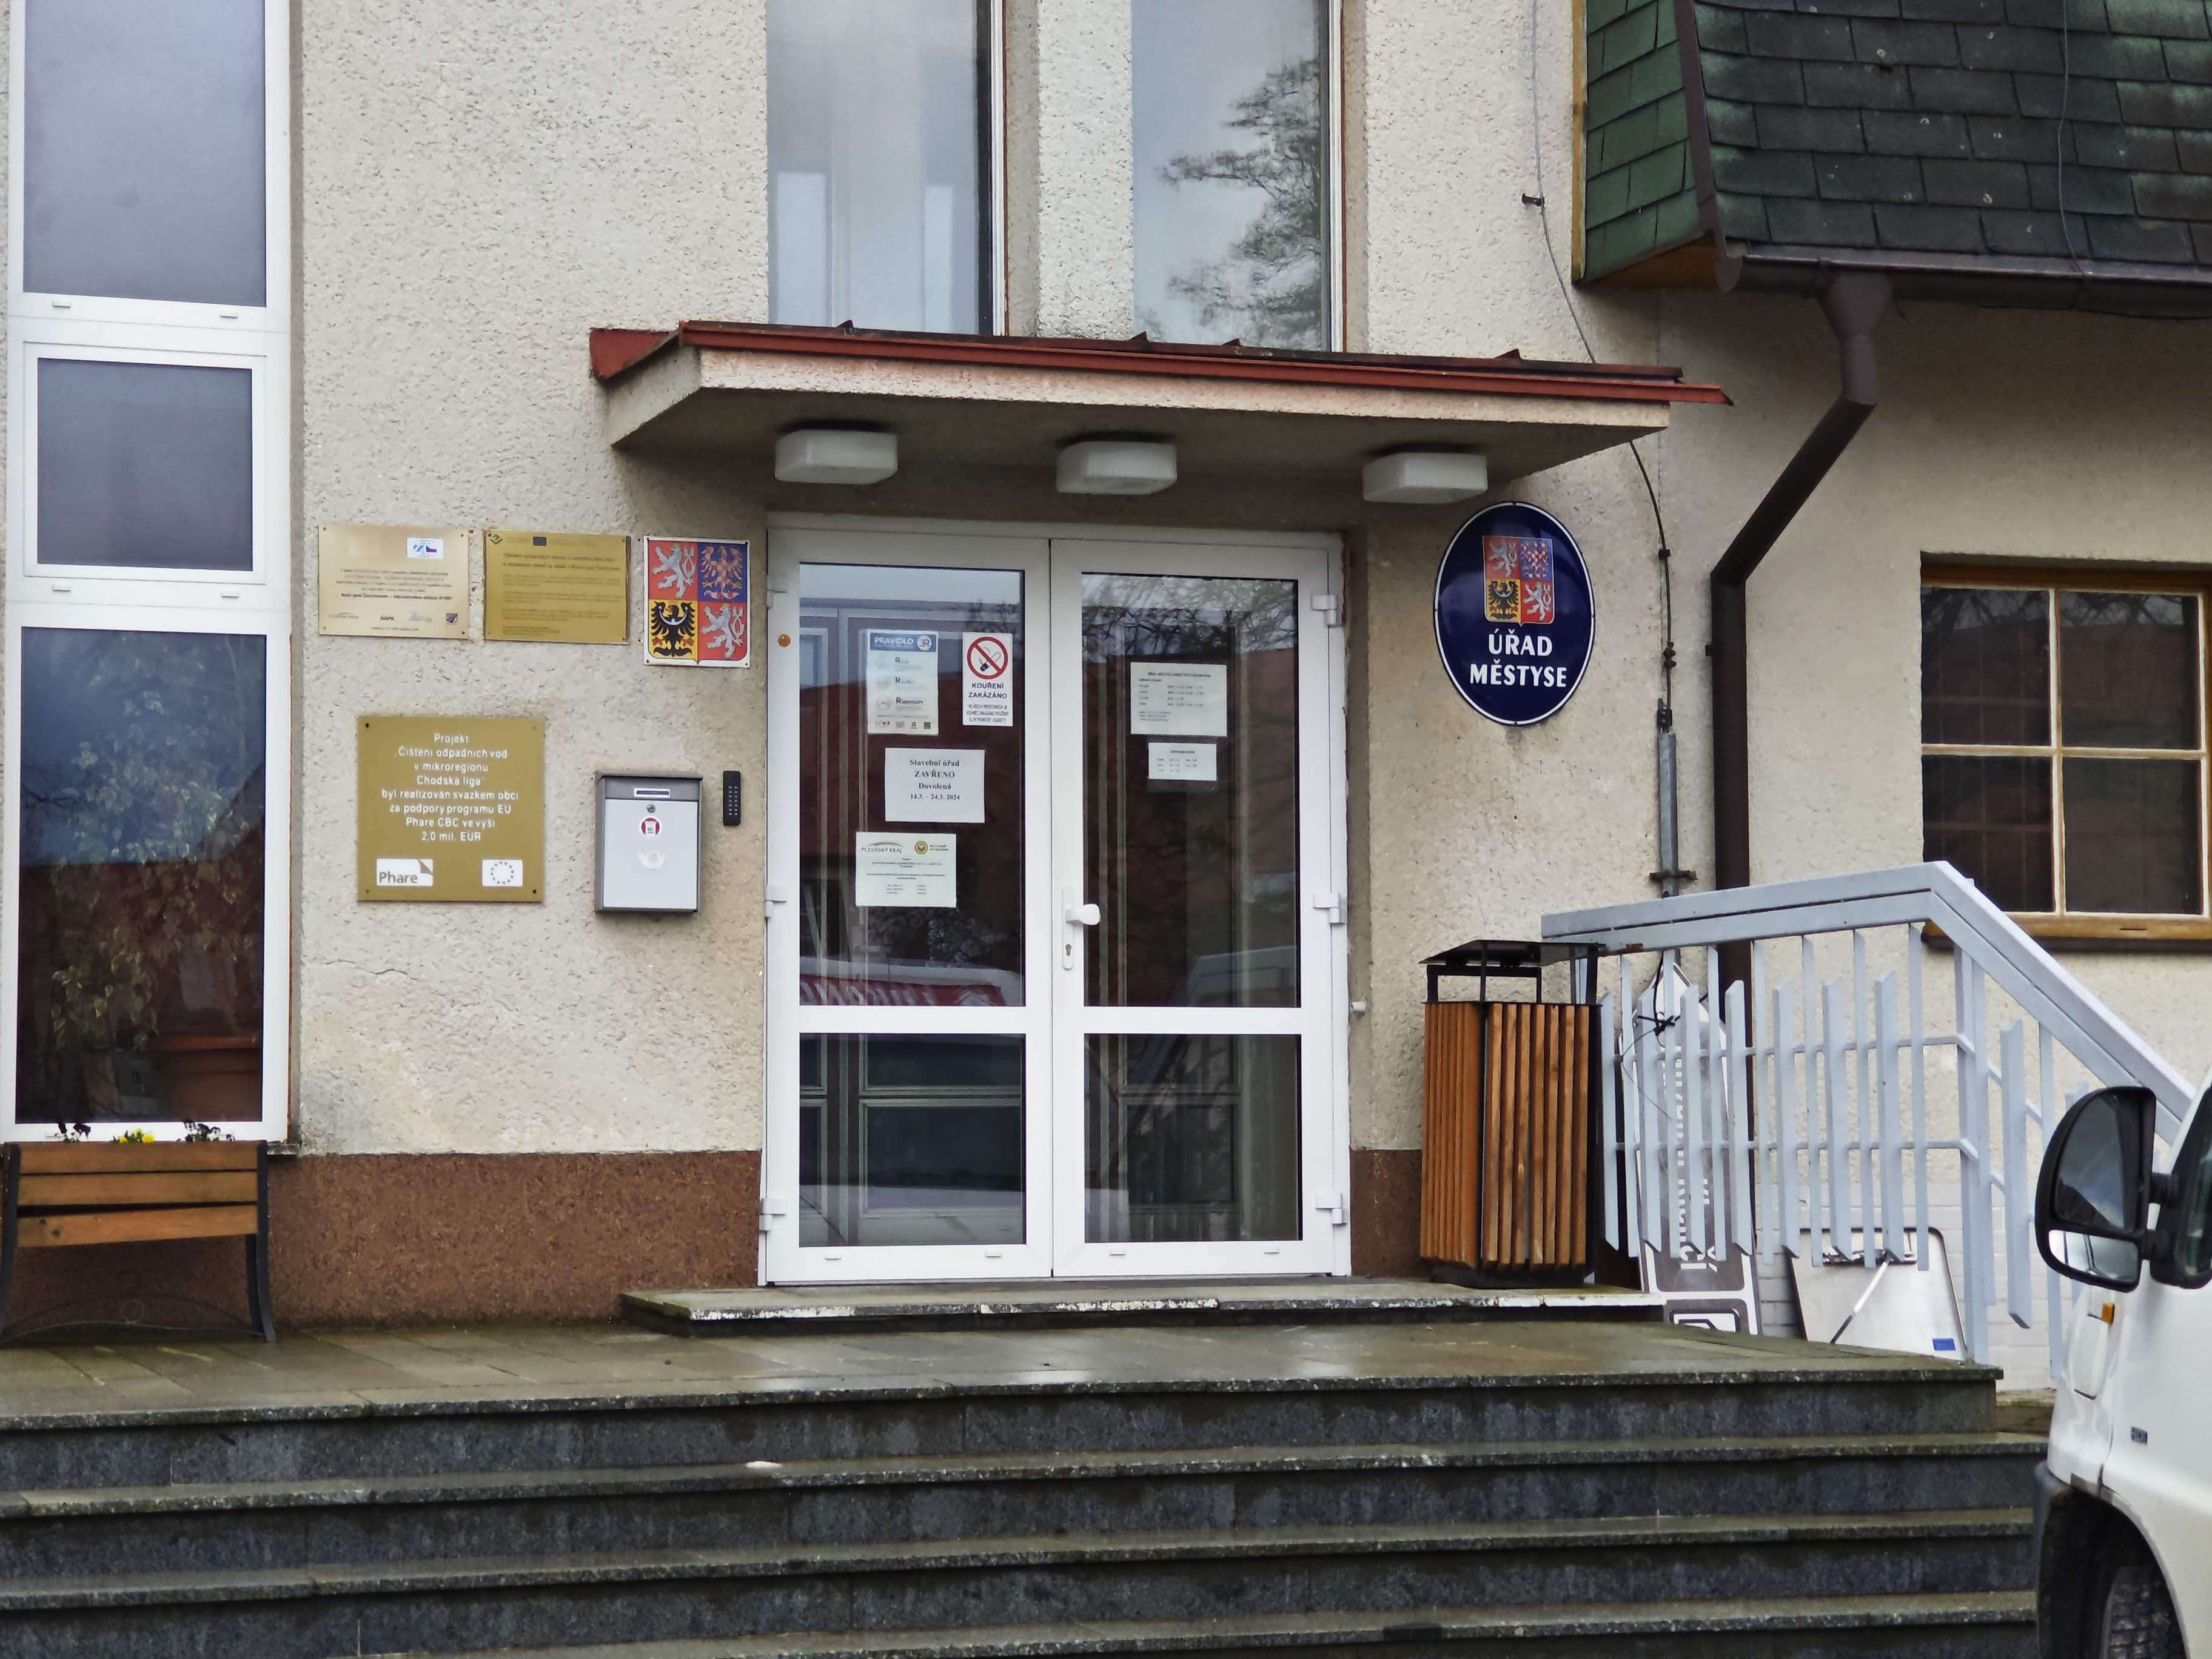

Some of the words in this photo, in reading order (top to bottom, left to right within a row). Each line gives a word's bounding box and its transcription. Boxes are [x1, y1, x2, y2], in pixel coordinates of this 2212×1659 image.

[1489, 628, 1552, 656] ÚŘAD
[1470, 659, 1567, 688] MĚSTYSE
[434, 734, 469, 745] Projekt
[490, 749, 508, 758] vod
[423, 762, 488, 774] mikroregionu
[914, 769, 955, 778] ZAVŘENO
[463, 777, 481, 788] liga
[381, 789, 397, 800] byl
[453, 791, 494, 800] svazkem
[403, 803, 444, 815] podpory
[446, 805, 494, 816] programu
[498, 804, 511, 814] EU
[406, 817, 434, 827] Phare
[437, 817, 459, 827] CBC
[439, 832, 456, 841] mil.
[460, 831, 481, 841] EUR
[379, 870, 418, 883] Phare
